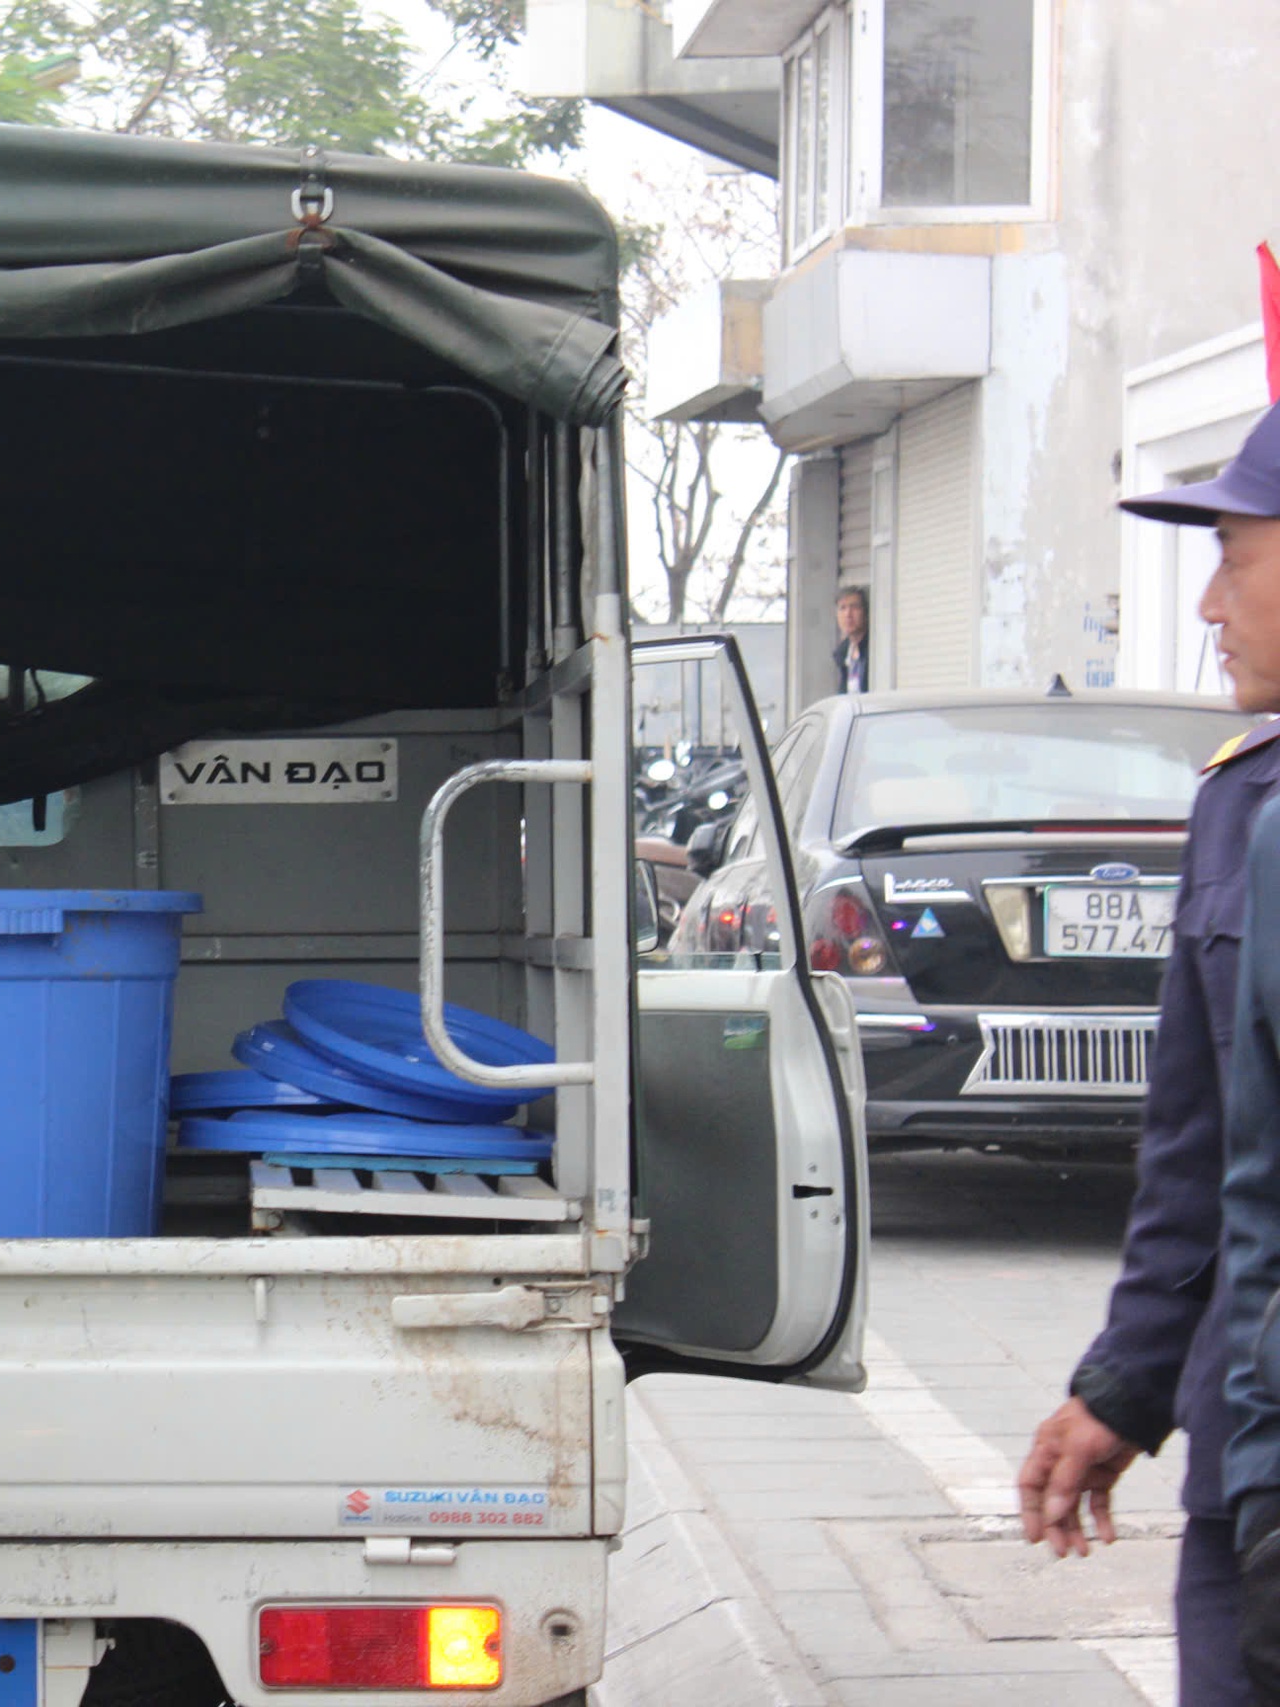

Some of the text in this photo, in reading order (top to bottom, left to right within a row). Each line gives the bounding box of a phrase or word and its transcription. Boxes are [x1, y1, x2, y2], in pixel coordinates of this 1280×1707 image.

[174, 754, 386, 789] VÂN ĐẠO
[1086, 894, 1142, 919] 88A
[1062, 925, 1170, 951] 577.47
[385, 1490, 452, 1503] SUZUKI
[429, 1511, 471, 1524] 0988
[476, 1512, 507, 1524] 302
[513, 1512, 544, 1525] 882
